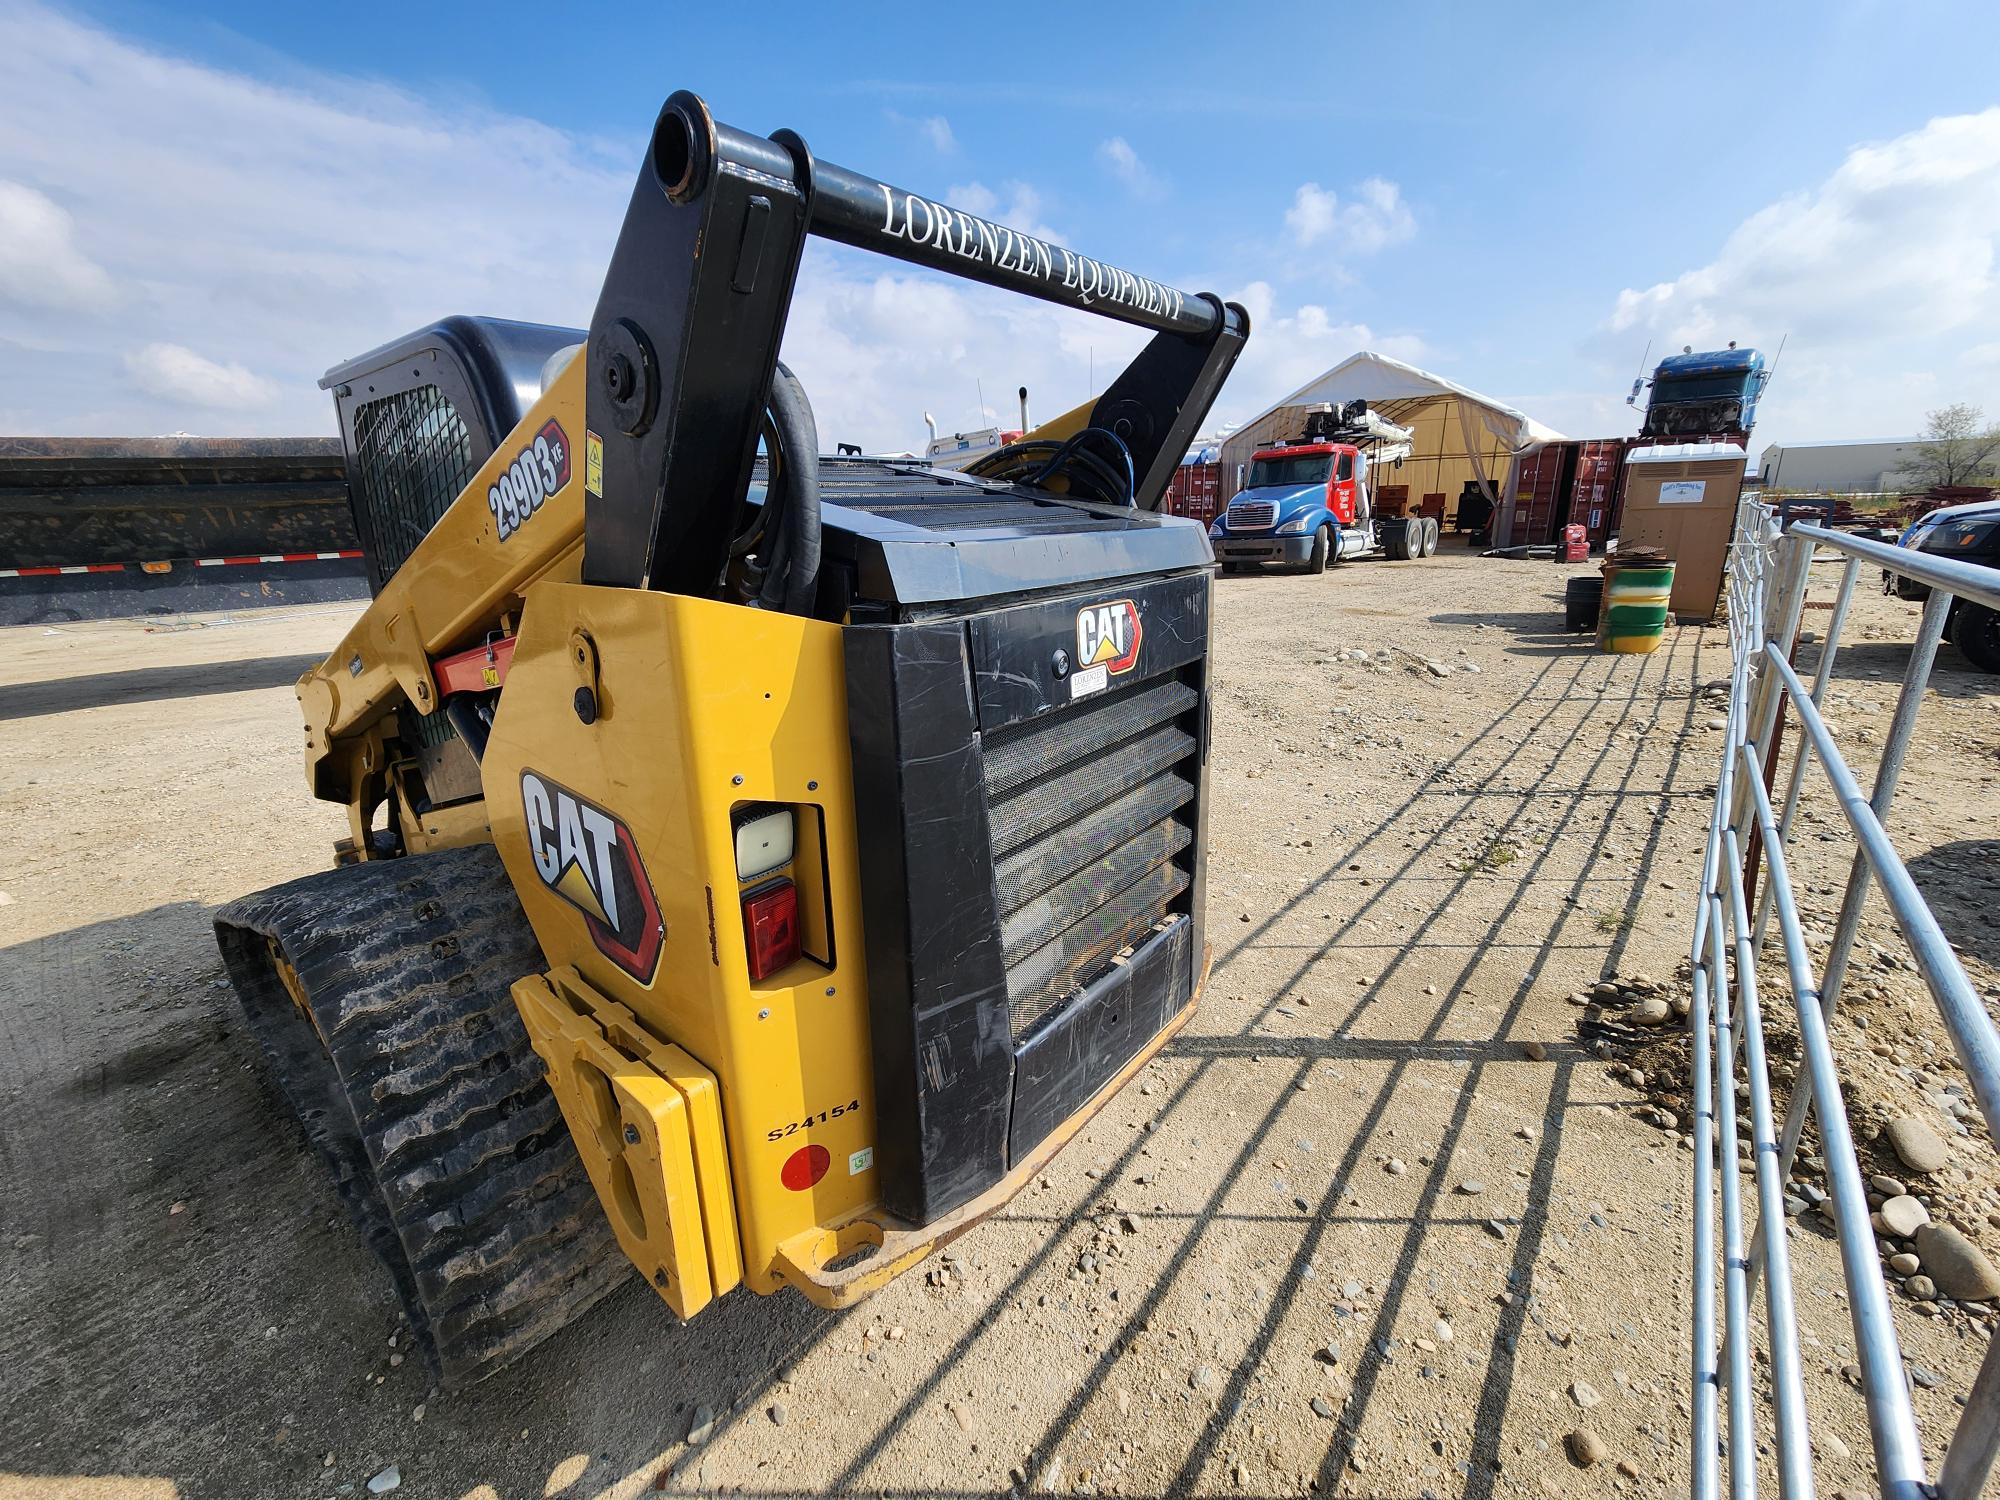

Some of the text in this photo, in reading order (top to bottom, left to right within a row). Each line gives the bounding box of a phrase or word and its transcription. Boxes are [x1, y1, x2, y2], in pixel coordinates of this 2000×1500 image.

[878, 184, 1183, 320] LORENZEN EQUIPMENT
[489, 435, 564, 539] 299D3 XE
[1079, 603, 1126, 665] CAT
[523, 774, 620, 934] CAT
[767, 1099, 860, 1142] S24154
